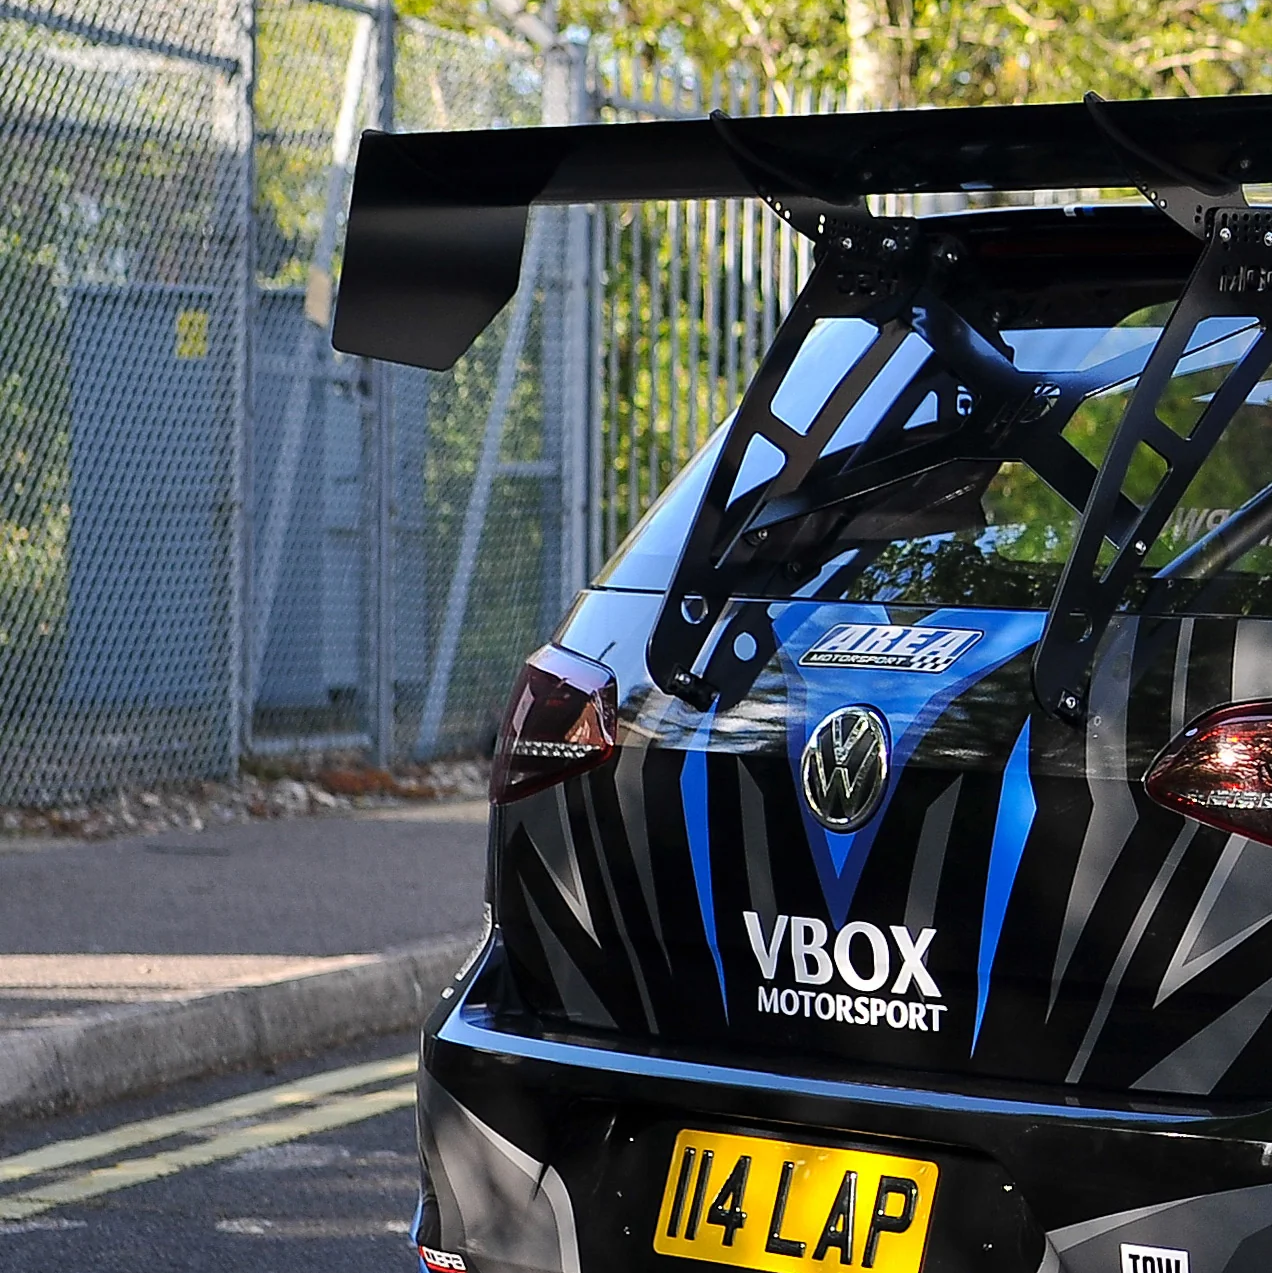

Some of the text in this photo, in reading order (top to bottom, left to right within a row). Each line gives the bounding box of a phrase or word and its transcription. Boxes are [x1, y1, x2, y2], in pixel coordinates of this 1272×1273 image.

[810, 652, 906, 666] MOTORSPORT
[819, 626, 962, 658] AREA
[743, 910, 942, 998] VBOX
[756, 984, 948, 1033] MOTORSPORT
[666, 1146, 920, 1269] 114 LAP
